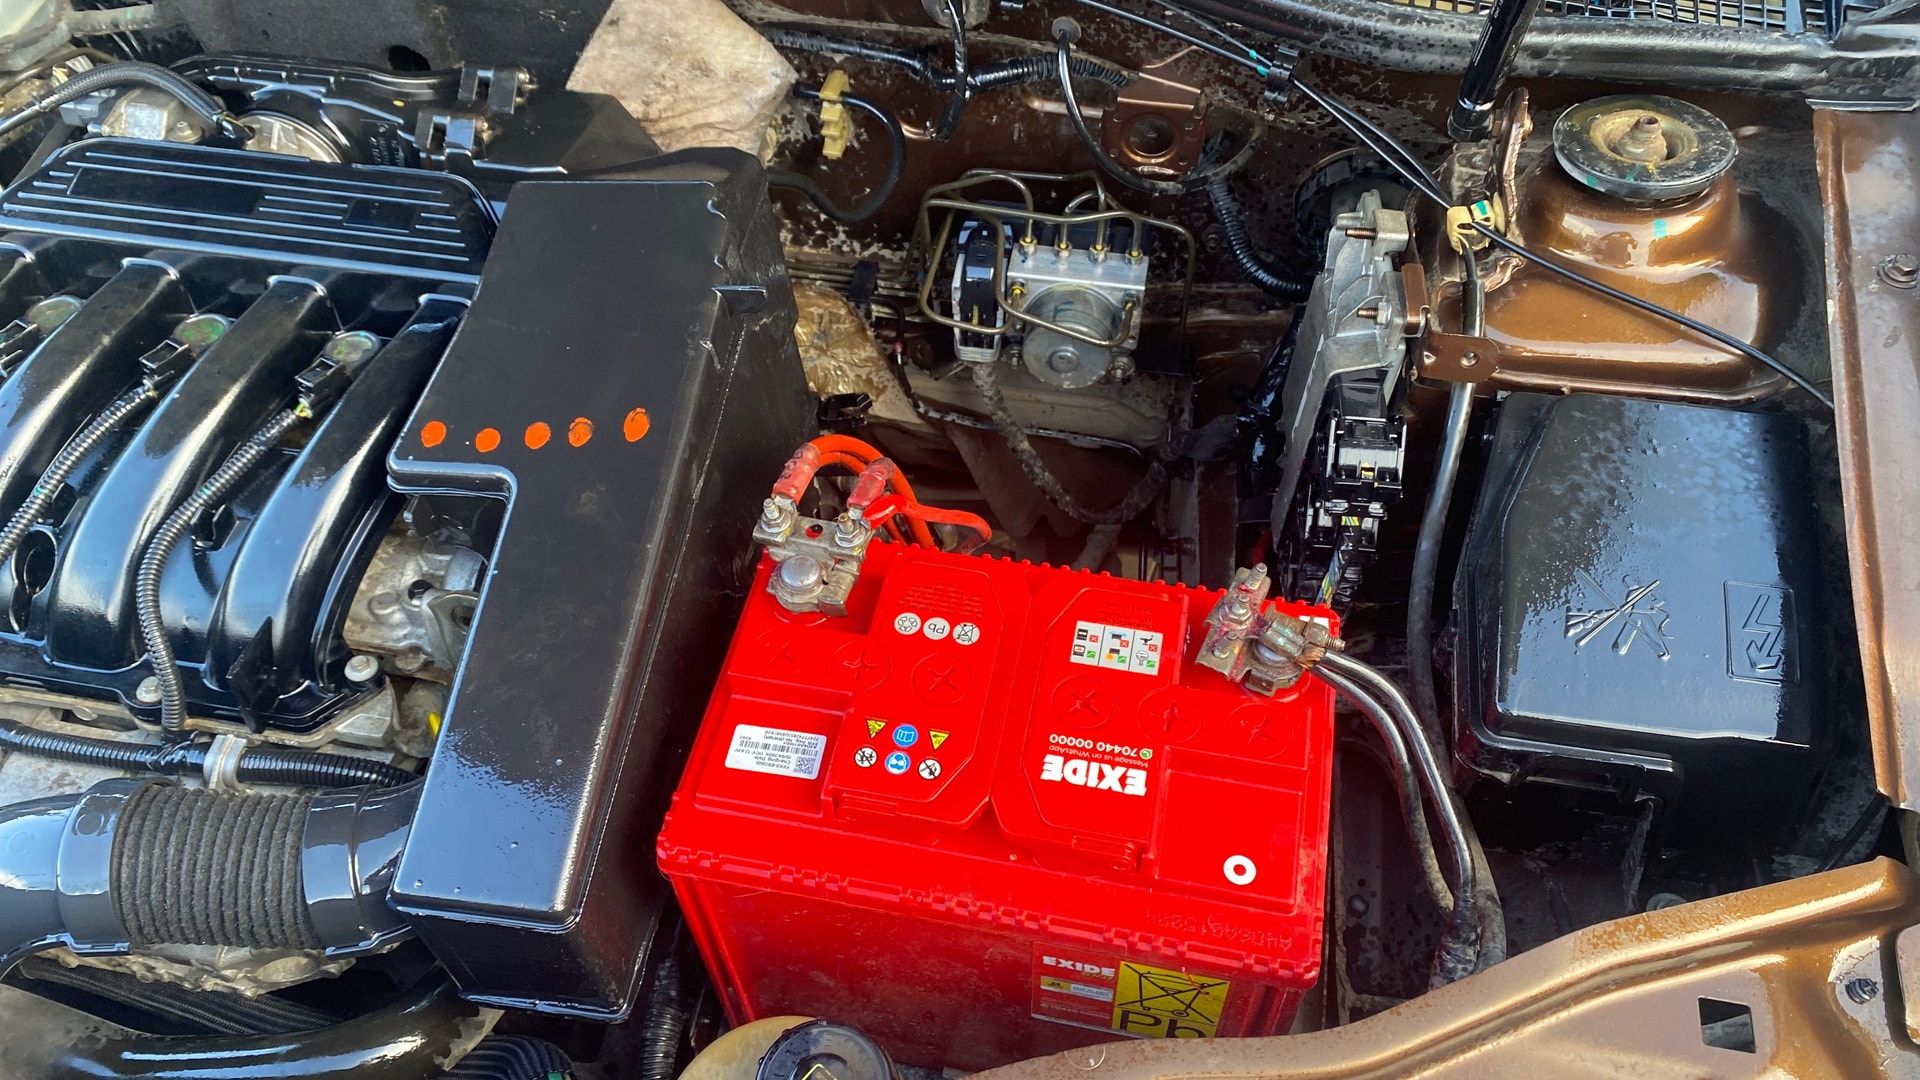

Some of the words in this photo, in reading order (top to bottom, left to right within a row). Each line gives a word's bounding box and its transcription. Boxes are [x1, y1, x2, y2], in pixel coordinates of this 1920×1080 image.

[928, 620, 946, 636] Pb
[1049, 733, 1094, 749] 00000
[1048, 745, 1090, 758] WhatsApp
[1092, 752, 1103, 760] on
[1096, 742, 1138, 757] 70440
[767, 757, 791, 765] Charging
[1114, 756, 1149, 768] Message
[1040, 754, 1147, 796] EXIDE
[1042, 955, 1116, 977] EXIDE
[1119, 1009, 1206, 1039] Pb
